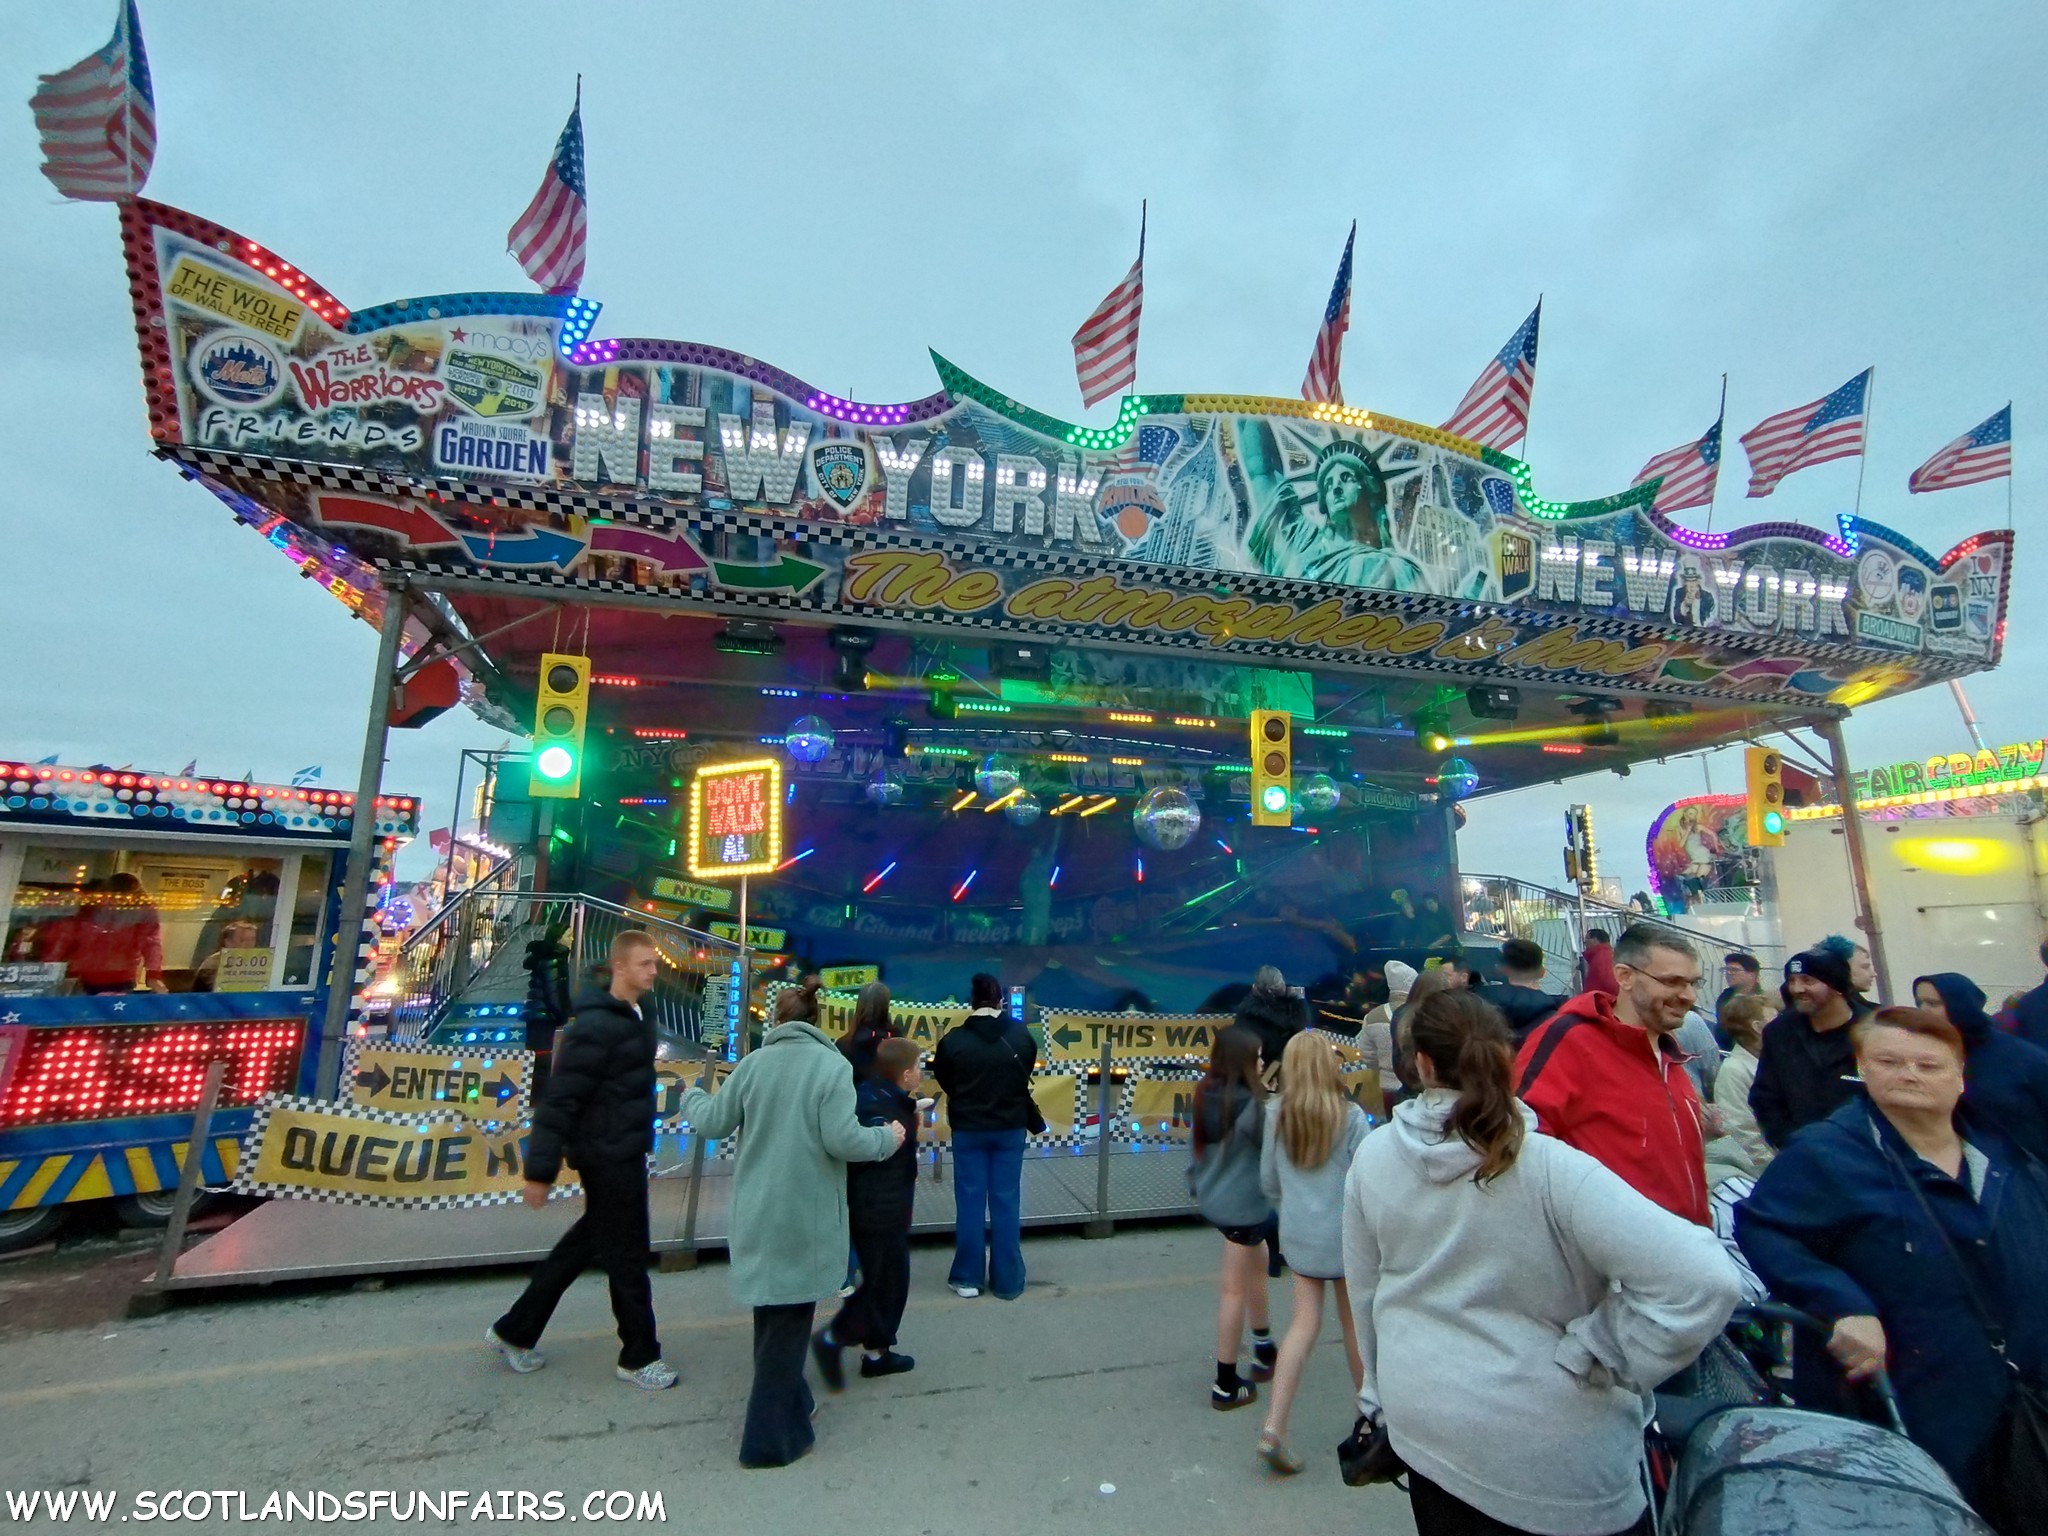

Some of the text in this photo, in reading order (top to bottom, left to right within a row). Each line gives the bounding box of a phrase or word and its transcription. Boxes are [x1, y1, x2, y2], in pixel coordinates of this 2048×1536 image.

[181, 266, 228, 299] THE
[233, 289, 300, 326] WOLF
[171, 284, 193, 297] OF
[195, 292, 234, 317] WALL
[238, 310, 293, 339] STREET
[327, 343, 373, 367] THE
[471, 331, 547, 360] macy's
[211, 359, 267, 386] Mets
[467, 357, 523, 377] NEW YORK CITY
[454, 384, 478, 396] 2015
[504, 397, 528, 409] 2018
[461, 421, 528, 443] MADISON SQUARE
[440, 427, 548, 476] GARDEN
[815, 453, 864, 468] DEPARTMENT
[824, 446, 853, 455] POLICE
[573, 392, 1106, 544] NEW YORK
[818, 472, 838, 499] CITY OF
[1502, 534, 1529, 557] DONT
[1502, 556, 1530, 576] WALK
[1538, 533, 1850, 638] NEW YORK
[1968, 576, 1998, 597] NY
[849, 551, 1663, 676] The atmosphere is here
[1862, 615, 1918, 645] BROADWAY
[1926, 739, 2045, 791] CRAZY
[1364, 790, 1413, 809] BROADWAY
[707, 801, 766, 836] WALK
[164, 878, 206, 889] THE BOSS
[673, 882, 713, 902] NYC
[223, 955, 268, 968] £3.00
[239, 969, 266, 977] PERSON
[1085, 1023, 1155, 1049] THIS
[389, 1066, 482, 1105] ENTER
[281, 1126, 472, 1183] QUEUE
